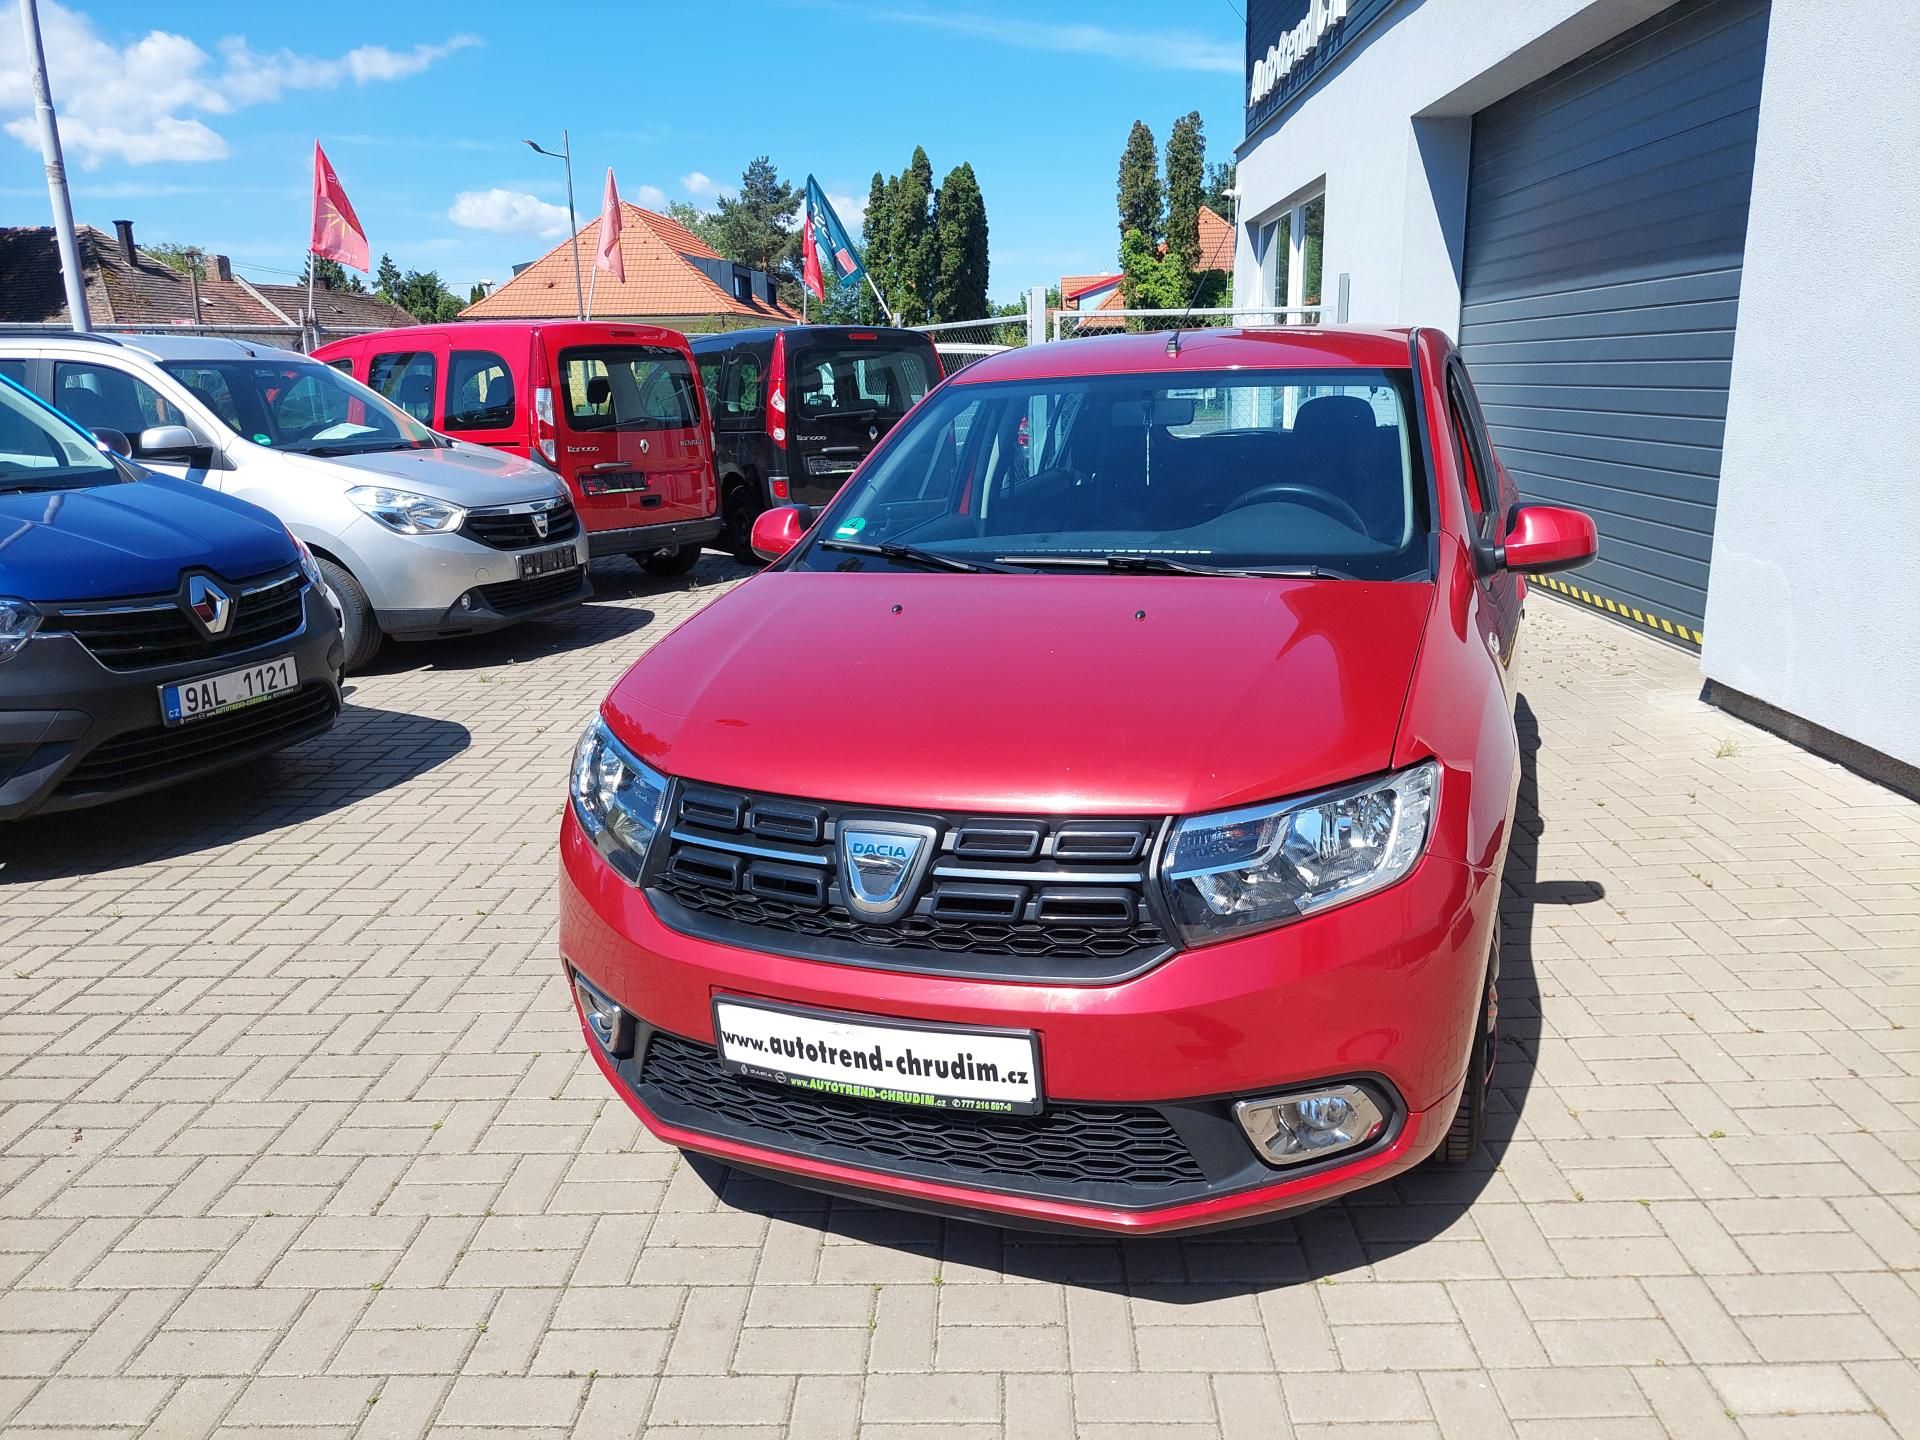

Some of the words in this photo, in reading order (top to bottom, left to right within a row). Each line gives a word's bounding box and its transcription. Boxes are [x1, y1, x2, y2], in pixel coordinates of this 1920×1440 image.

[185, 681, 226, 712] 9AL
[244, 663, 289, 696] 1121
[168, 708, 181, 718] CZ
[852, 842, 906, 857] DACIA
[721, 1030, 1028, 1085] www.autotrend-chrudim.cz
[750, 1069, 773, 1078] DACIA
[791, 1077, 946, 1107] www.AUTOTREND-CHRUDIM.cz
[961, 1099, 975, 1109] 777
